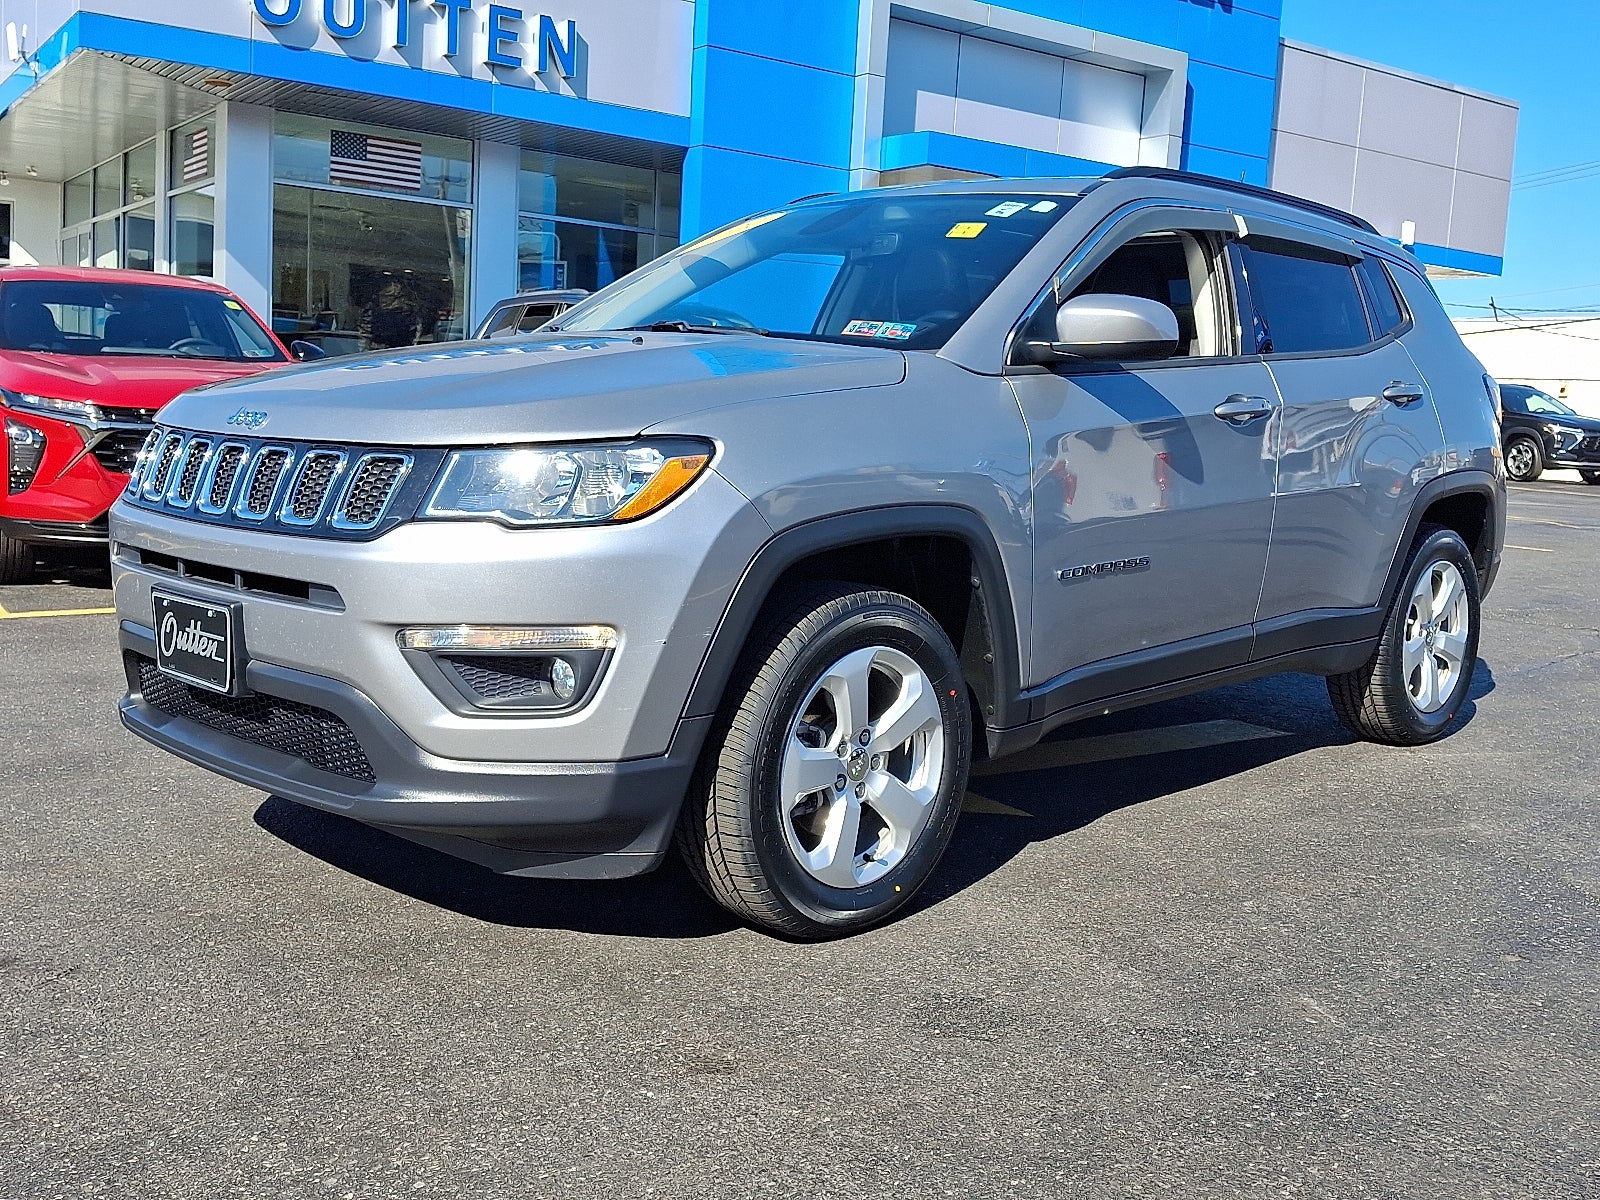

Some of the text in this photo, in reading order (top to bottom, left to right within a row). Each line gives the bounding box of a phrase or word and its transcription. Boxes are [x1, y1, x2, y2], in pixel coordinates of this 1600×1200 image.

[227, 406, 268, 430] Jeep
[1057, 556, 1150, 582] COMPASS
[161, 611, 225, 663] Outten
